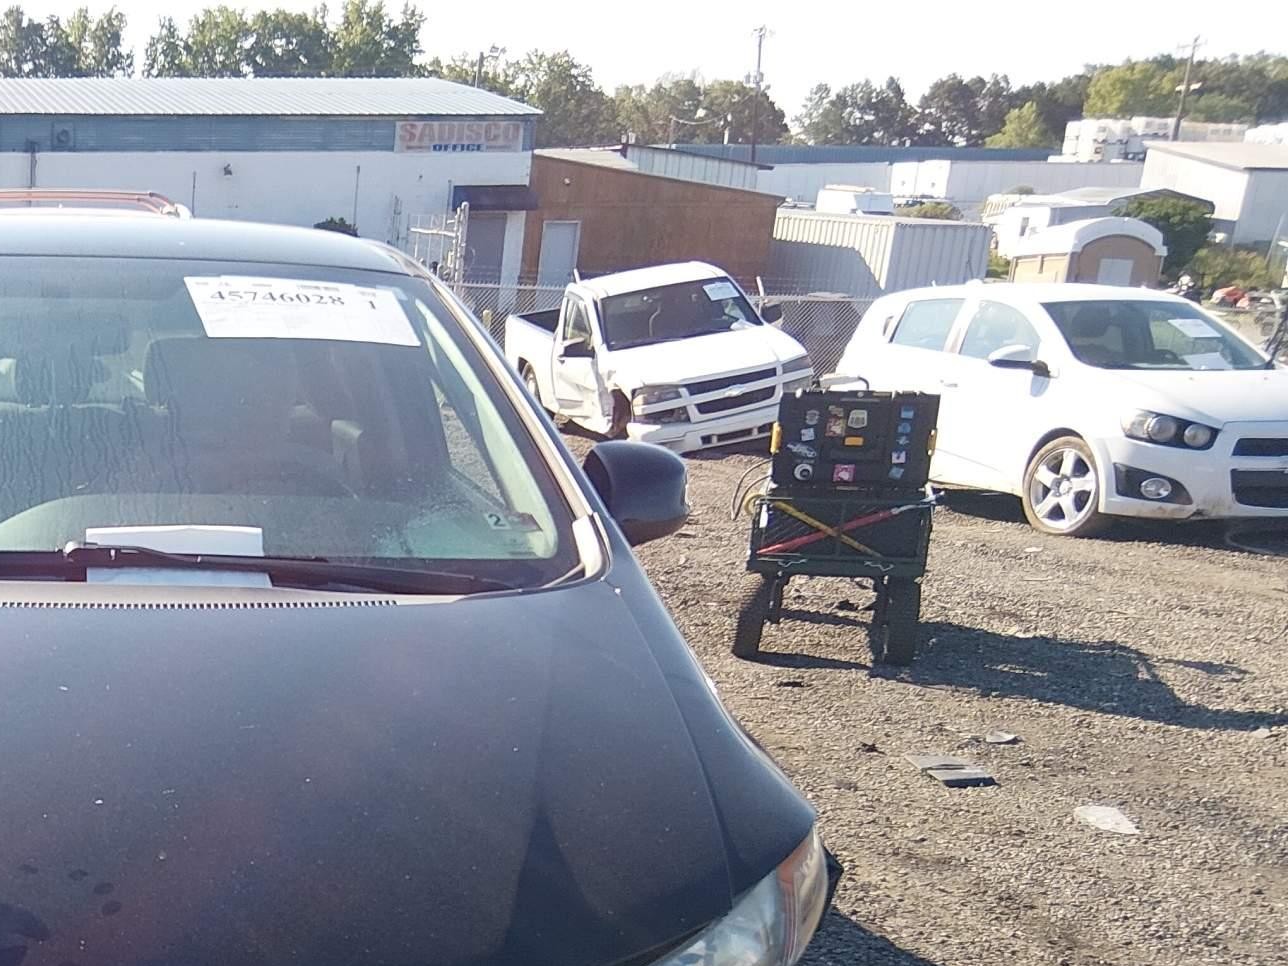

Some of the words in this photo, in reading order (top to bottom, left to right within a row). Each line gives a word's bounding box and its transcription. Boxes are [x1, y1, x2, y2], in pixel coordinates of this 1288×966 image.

[399, 123, 521, 142] SADISCO
[432, 143, 484, 152] OFFICE
[210, 290, 345, 306] 45746028
[367, 300, 376, 310] 1
[488, 513, 506, 527] 2
